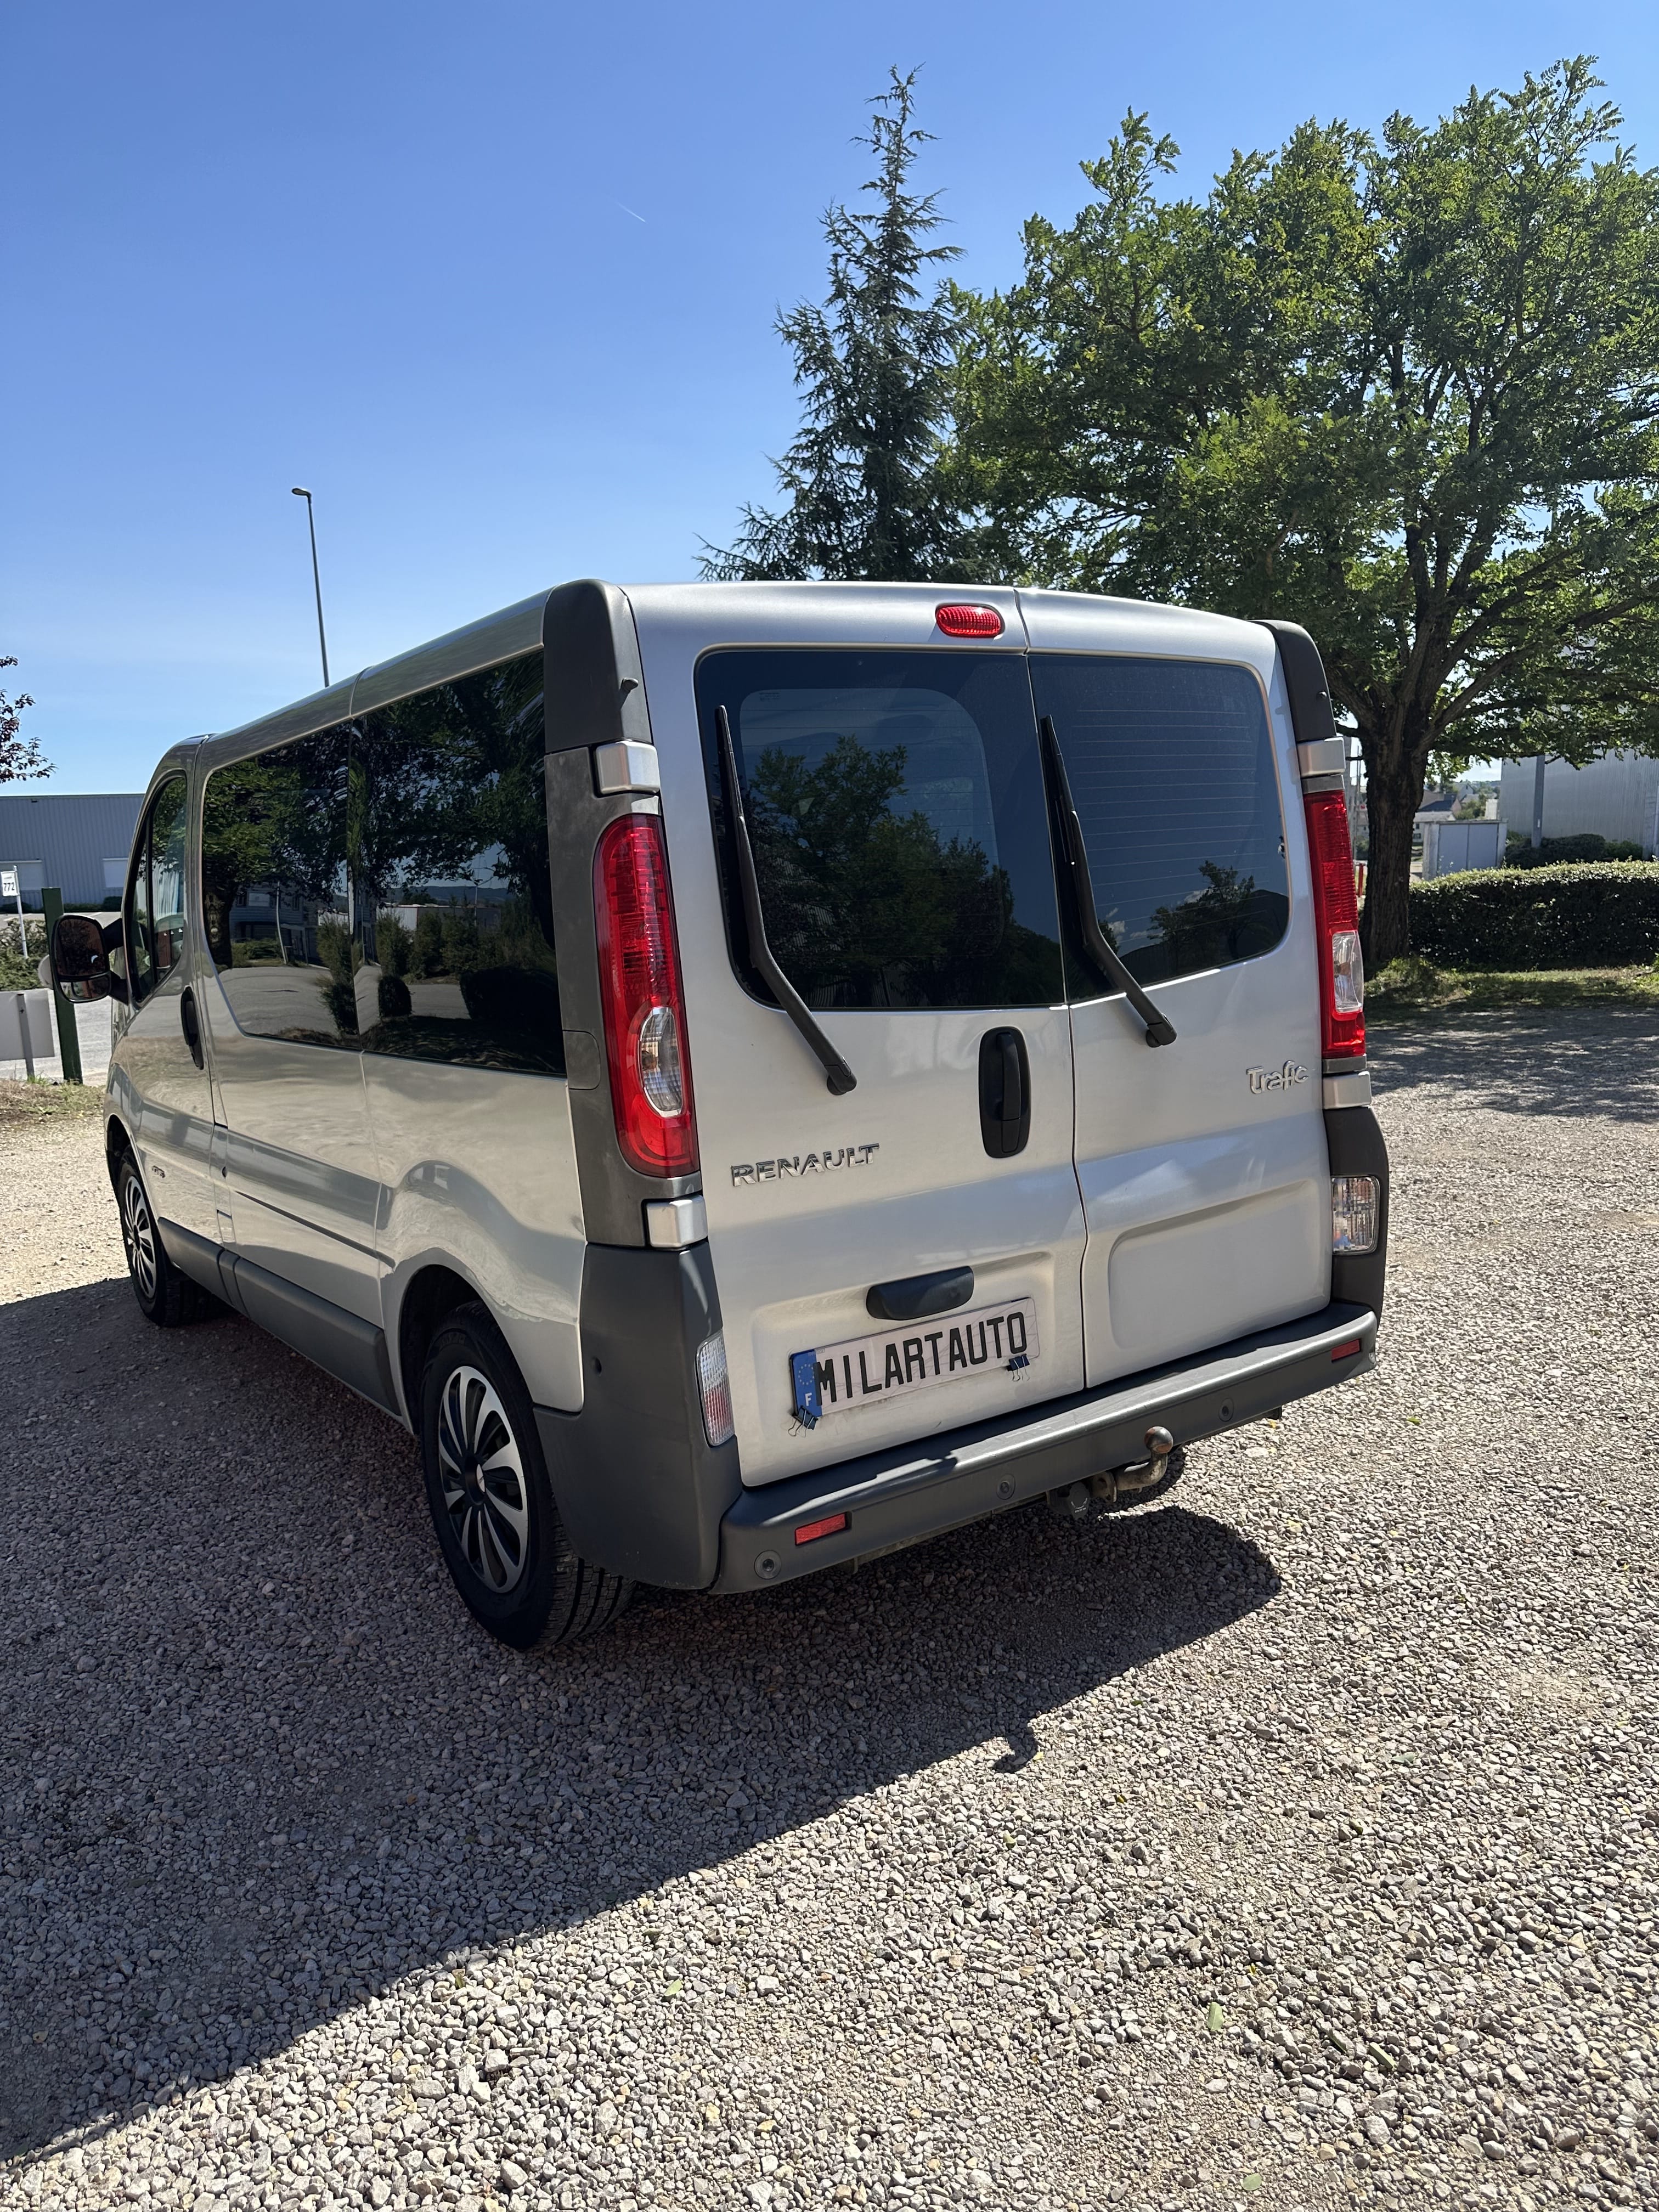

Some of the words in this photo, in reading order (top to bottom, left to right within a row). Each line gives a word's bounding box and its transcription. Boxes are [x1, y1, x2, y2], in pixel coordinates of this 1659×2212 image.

[1246, 1060, 1309, 1094] Trafic
[731, 1143, 880, 1187] RENAULT
[812, 1311, 1028, 1406] MILARTAUTO
[805, 1392, 812, 1407] F
